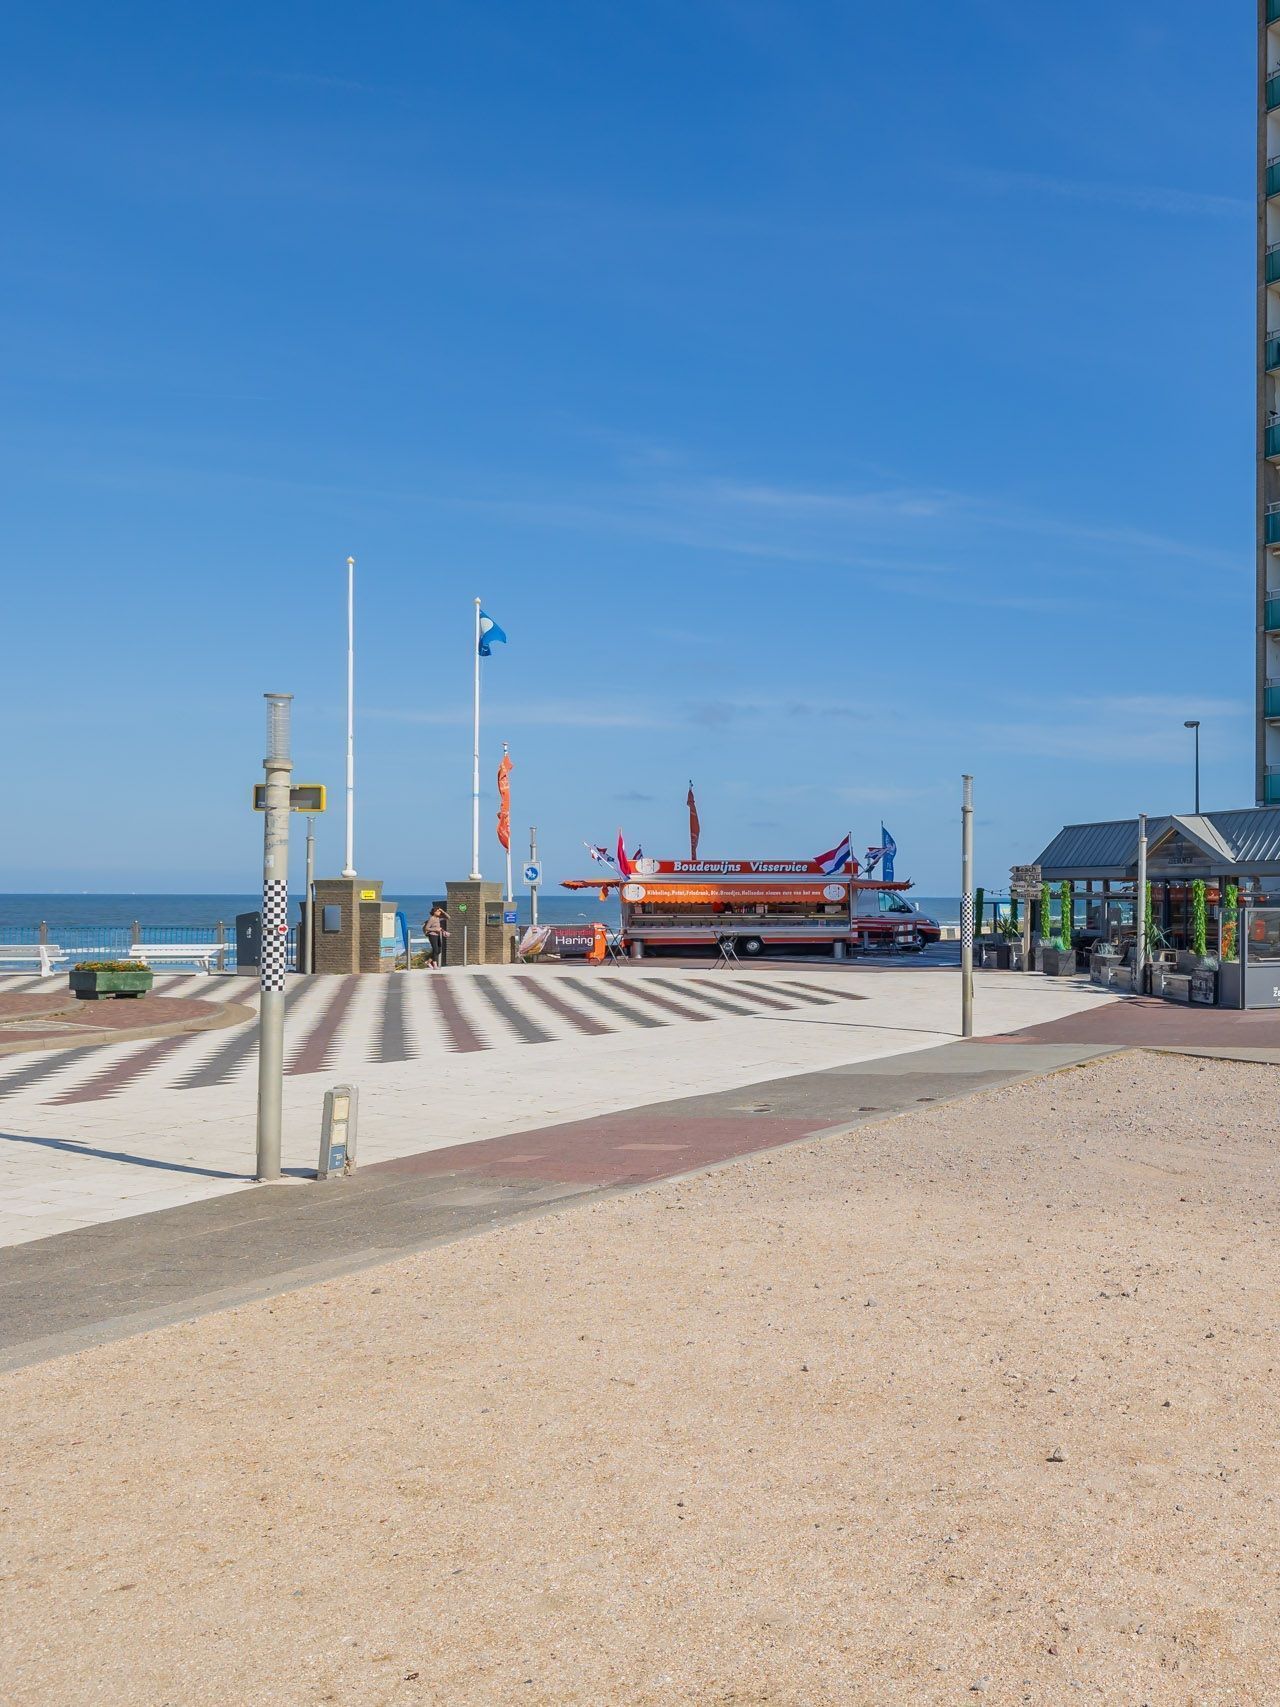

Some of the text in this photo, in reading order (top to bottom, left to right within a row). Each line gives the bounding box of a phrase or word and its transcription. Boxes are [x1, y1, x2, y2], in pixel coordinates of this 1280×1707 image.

[673, 861, 808, 874] Boudewijns Visservice
[1015, 865, 1037, 873] Beach
[555, 935, 594, 946] Haring
